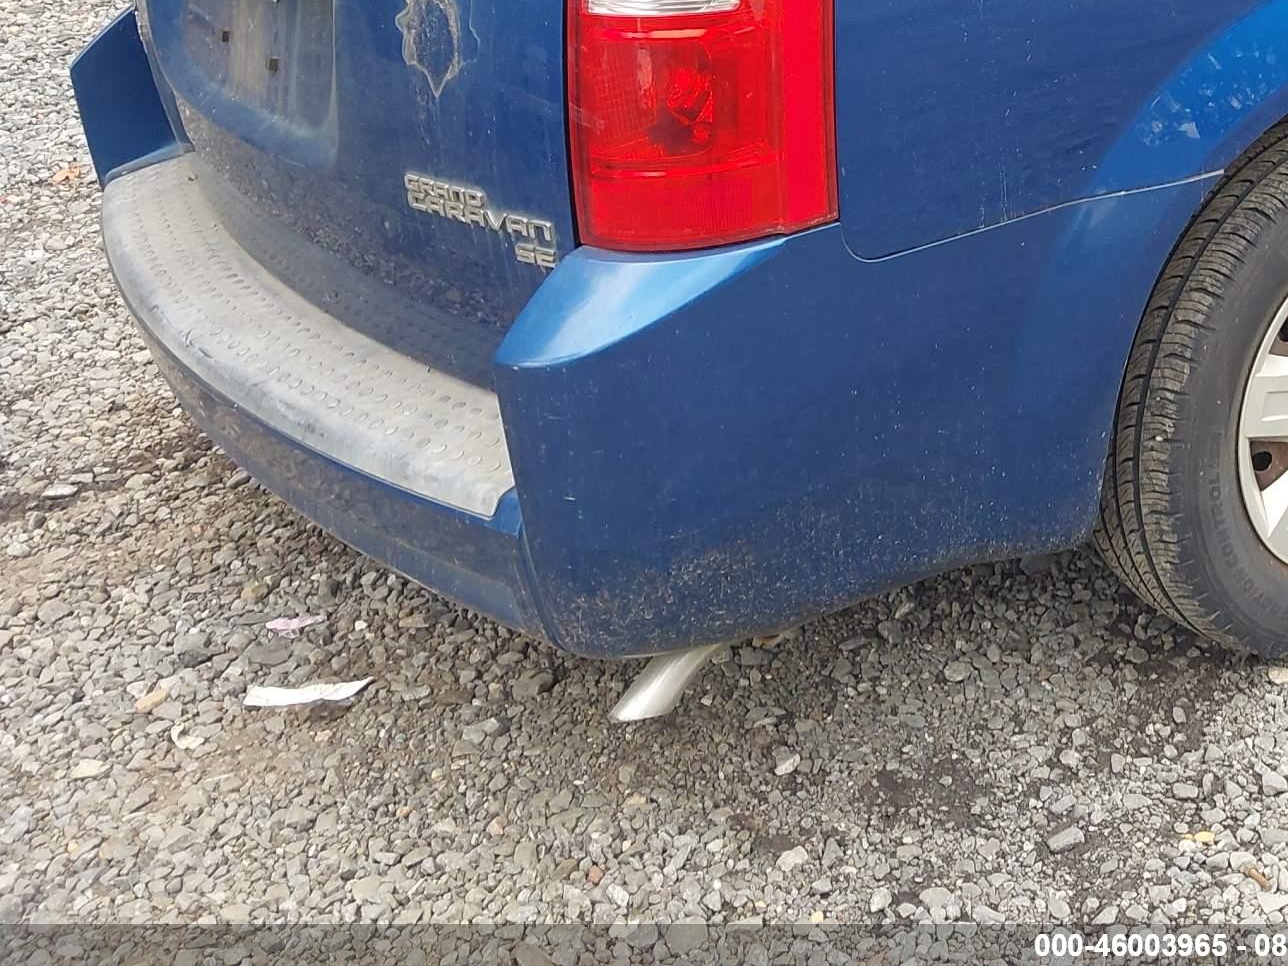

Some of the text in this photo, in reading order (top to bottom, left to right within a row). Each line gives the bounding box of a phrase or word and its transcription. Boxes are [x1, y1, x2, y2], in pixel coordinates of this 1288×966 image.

[404, 172, 485, 208] GRAND
[407, 191, 552, 241] CARAVAN
[515, 243, 557, 268] SE
